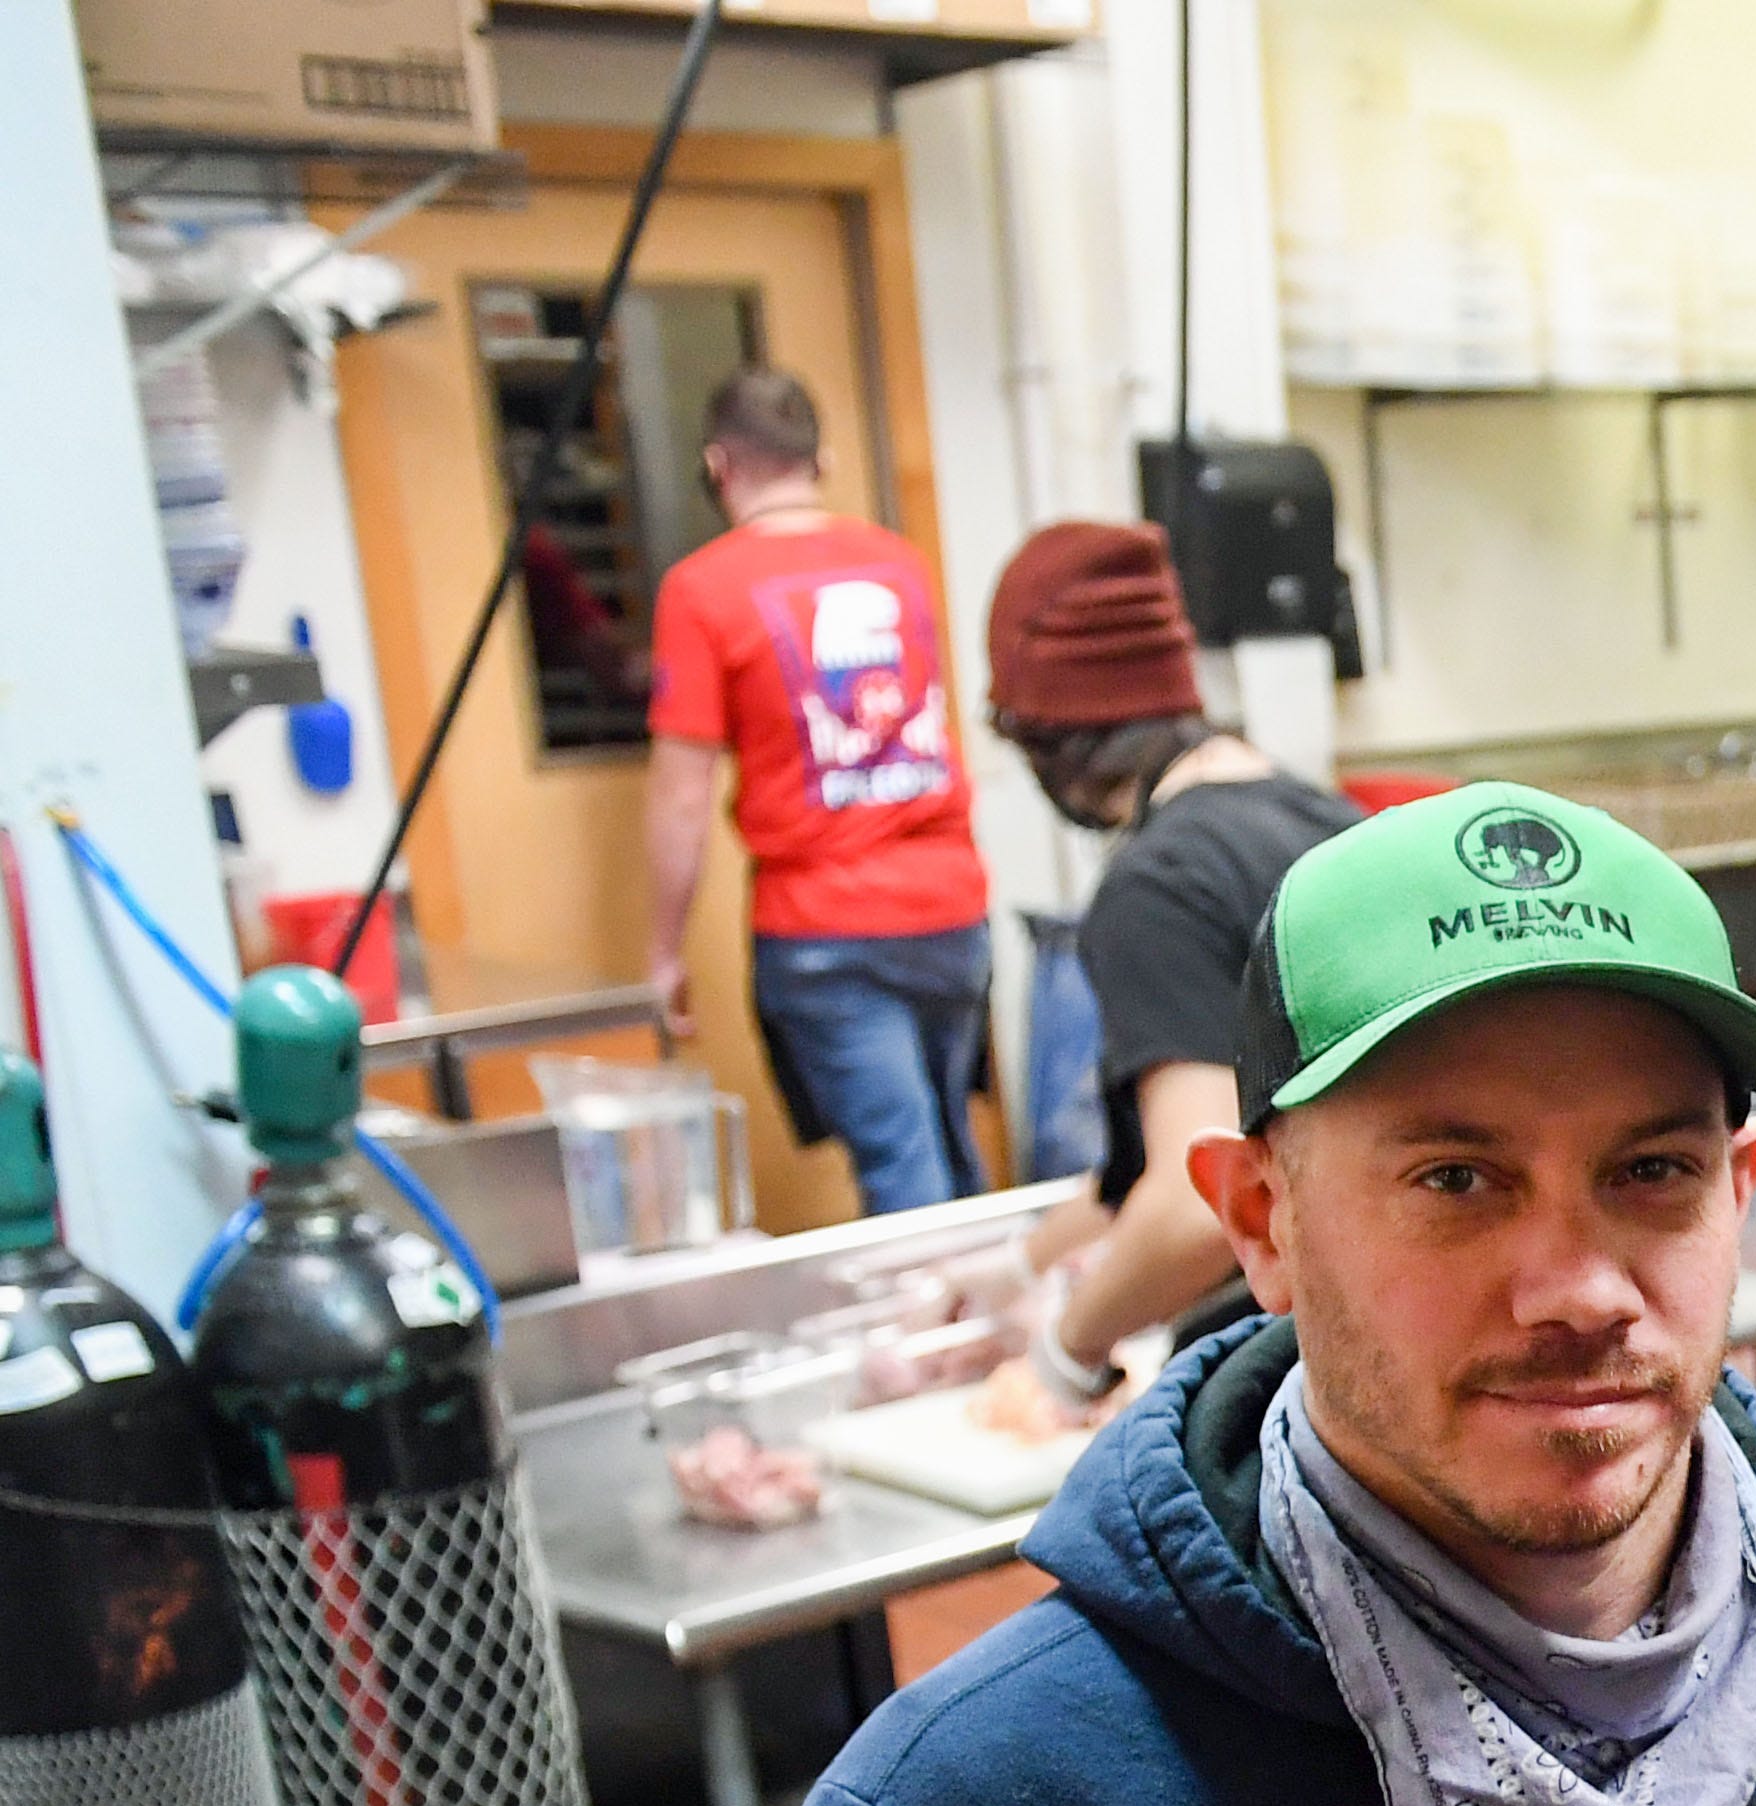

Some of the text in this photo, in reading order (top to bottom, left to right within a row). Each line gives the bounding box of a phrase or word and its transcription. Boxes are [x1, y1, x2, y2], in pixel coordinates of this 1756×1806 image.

[1428, 898, 1635, 950] MELVIN
[1352, 1587, 1383, 1646] COTTON
[1376, 1644, 1400, 1689] MADE
[1394, 1689, 1406, 1706] IN
[1400, 1706, 1423, 1755] CHINA
